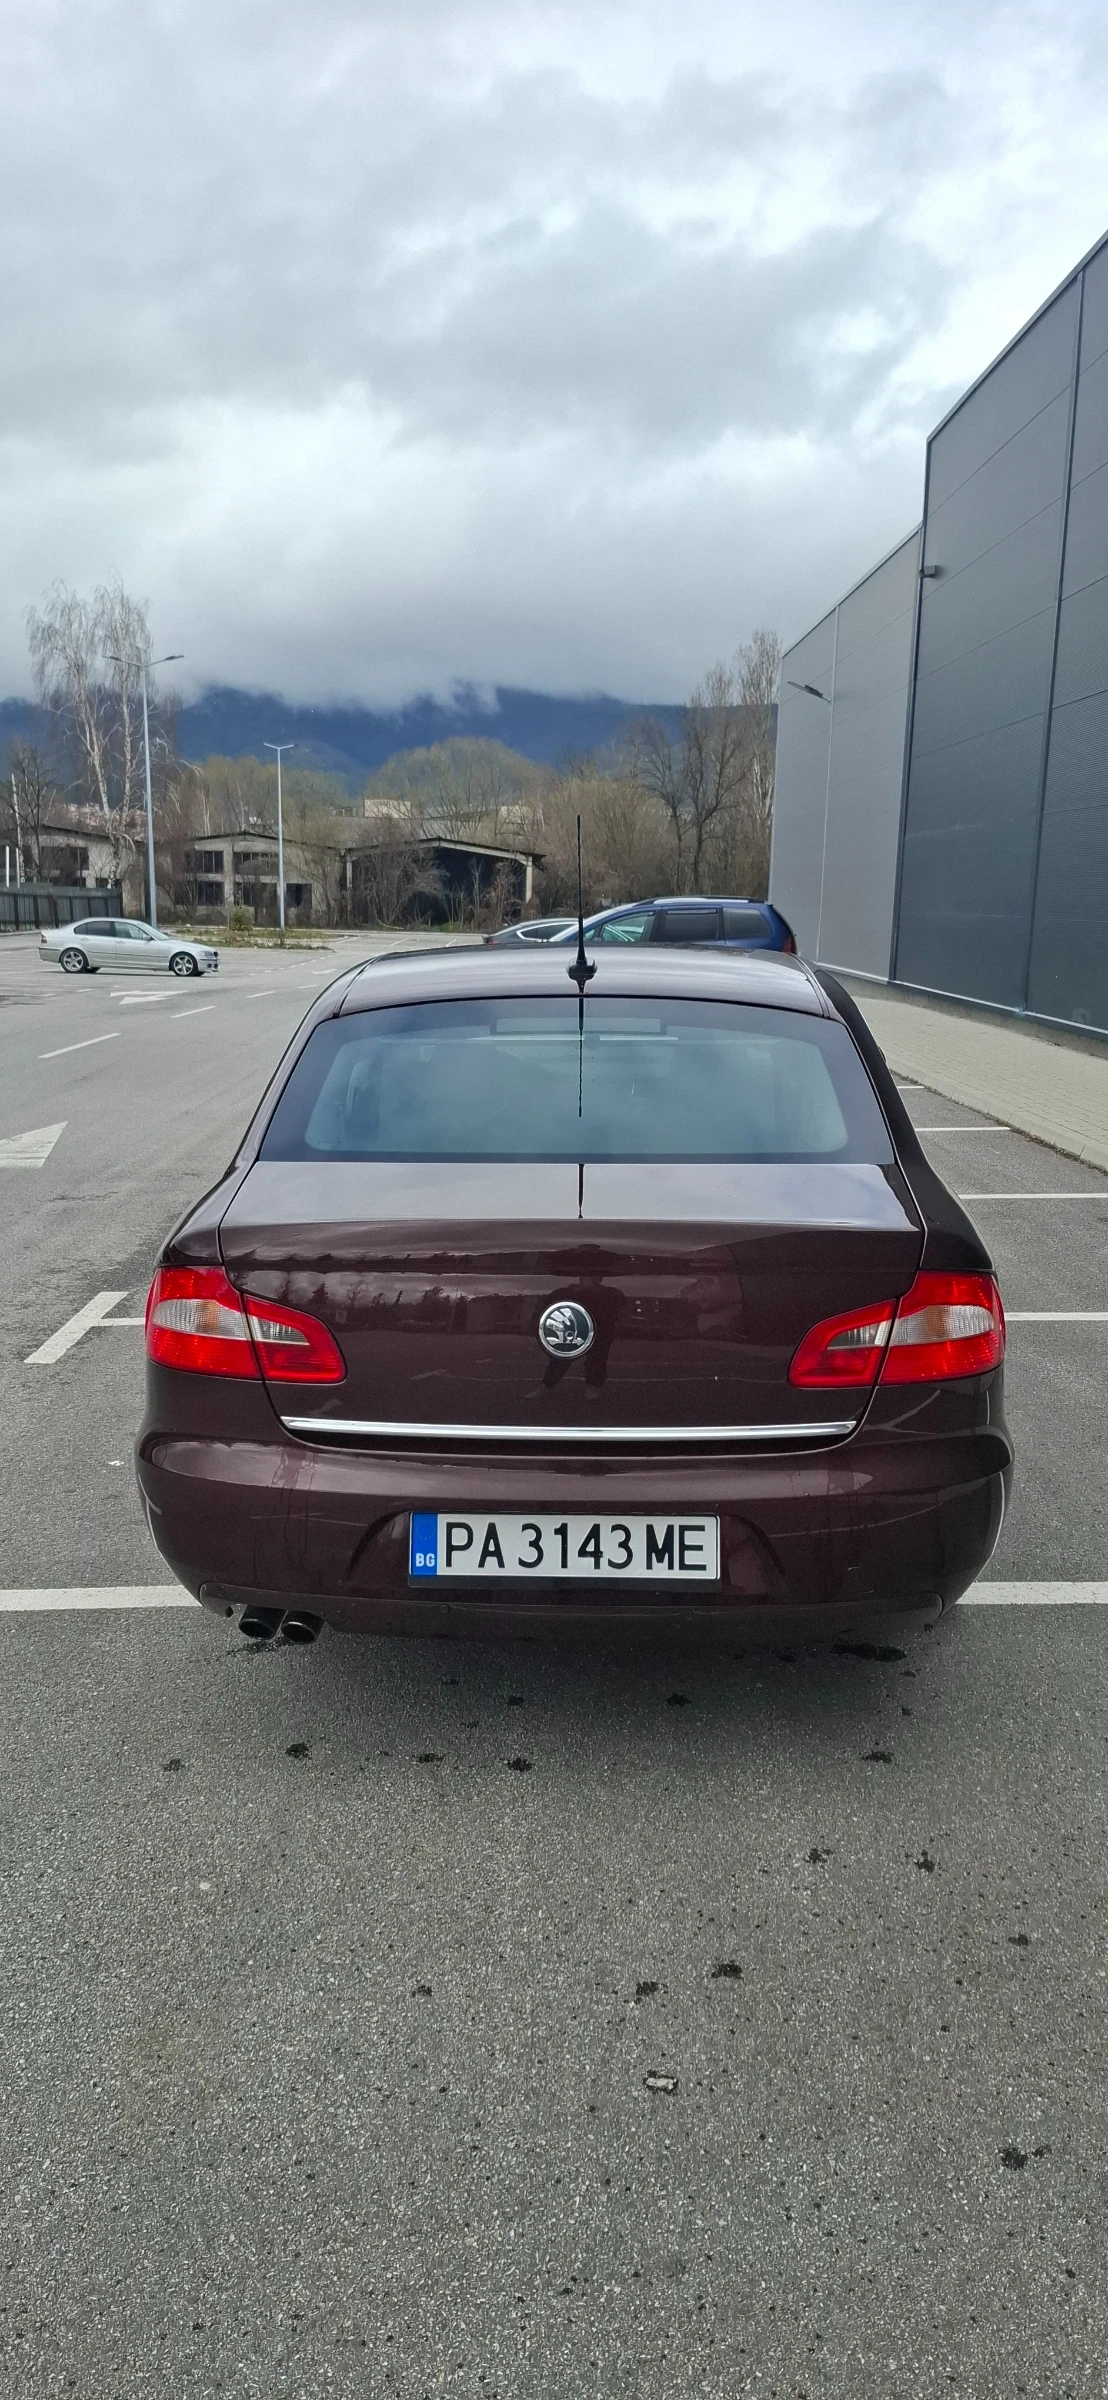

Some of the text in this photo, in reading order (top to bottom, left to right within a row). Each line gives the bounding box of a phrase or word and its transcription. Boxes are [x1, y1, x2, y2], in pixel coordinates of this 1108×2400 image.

[415, 1552, 435, 1567] BG
[445, 1522, 707, 1571] PA 3143 ME
